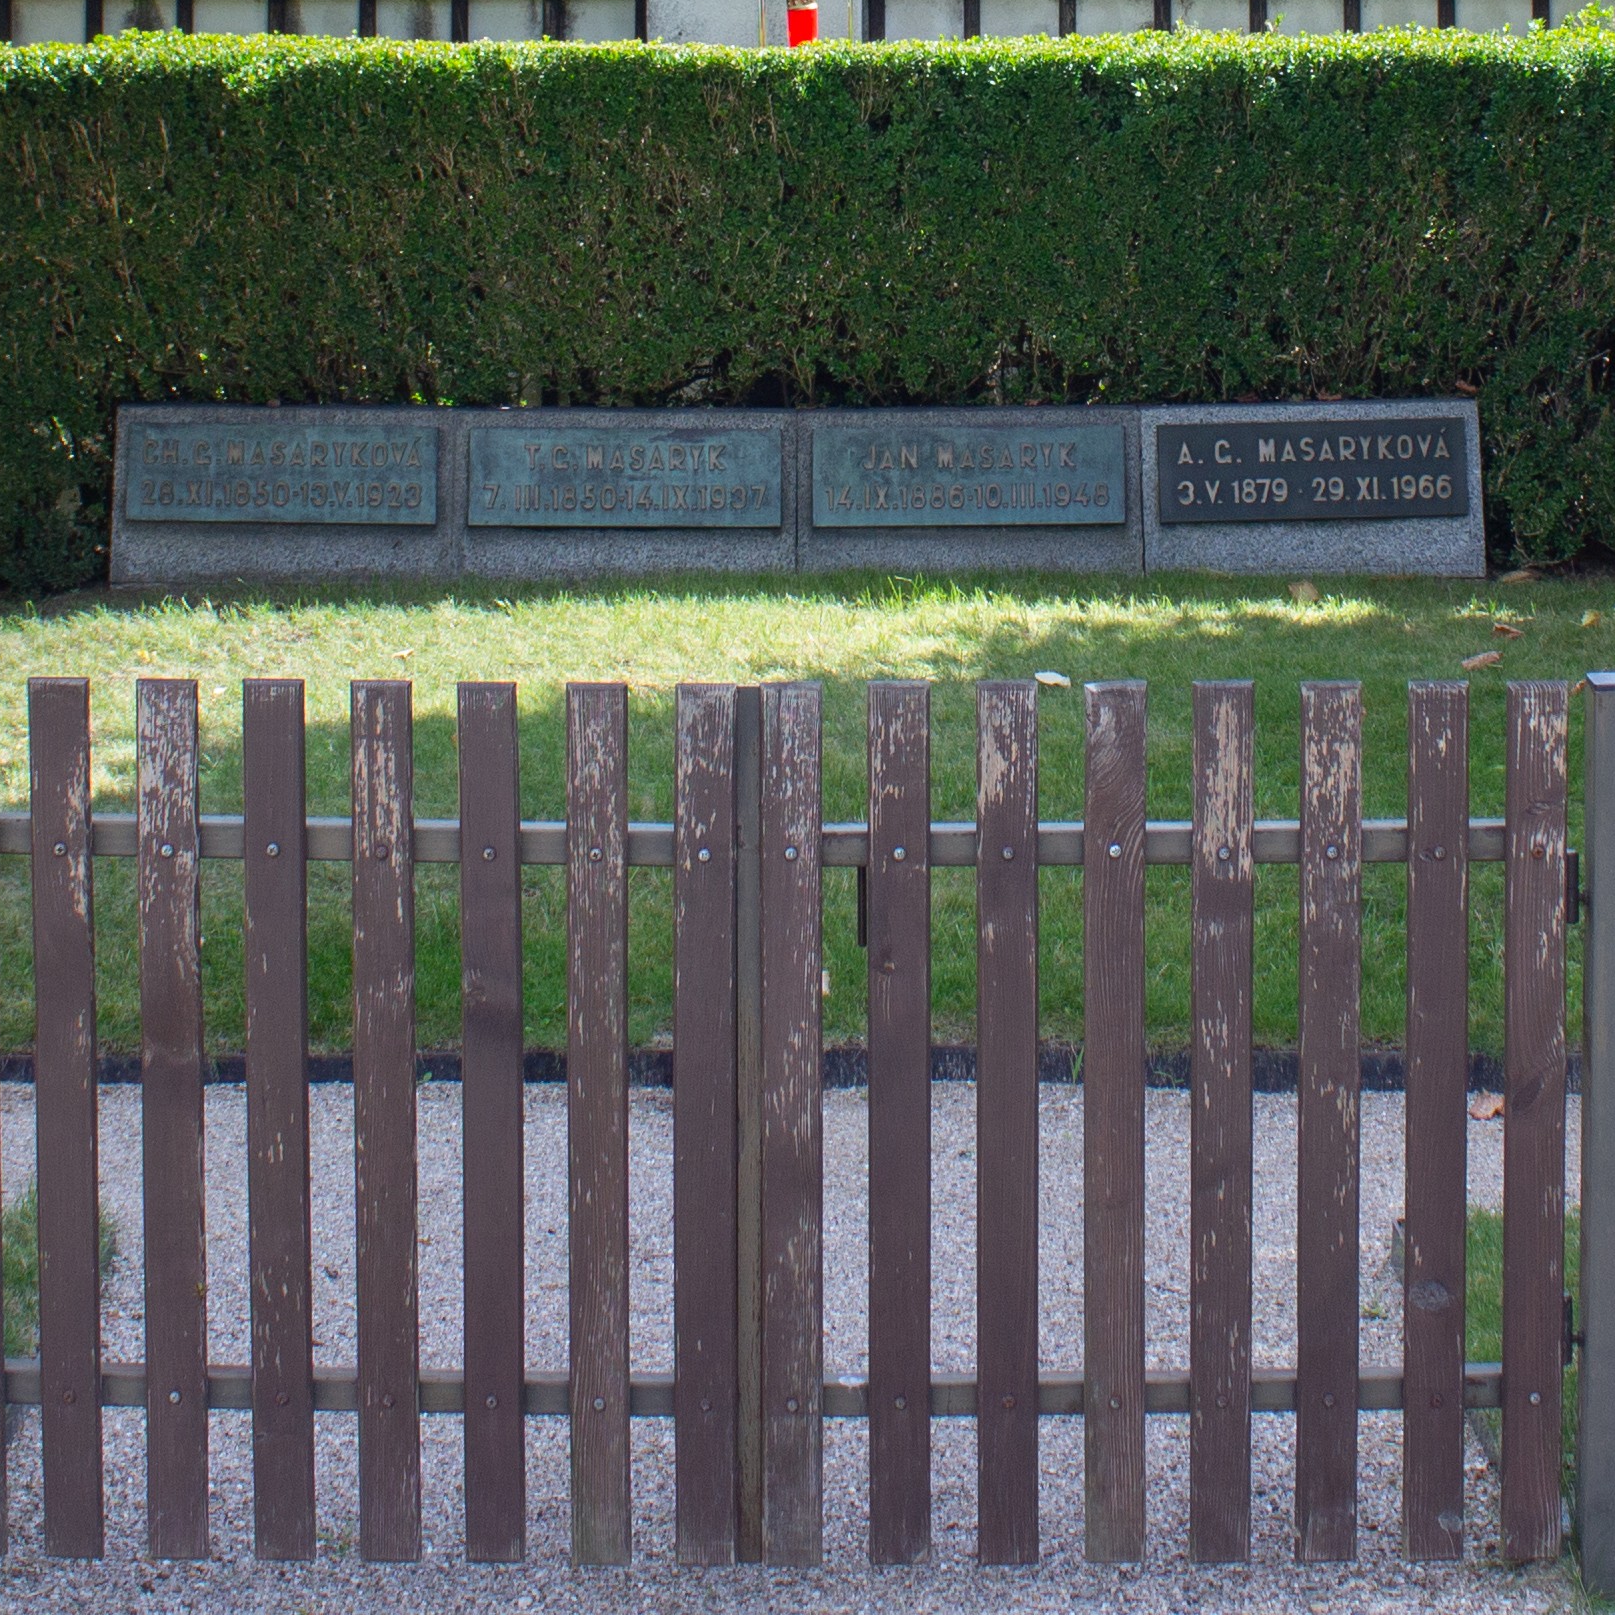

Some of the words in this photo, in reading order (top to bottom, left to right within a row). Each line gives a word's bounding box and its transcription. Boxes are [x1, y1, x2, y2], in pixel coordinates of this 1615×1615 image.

[586, 444, 727, 471] MASARYK
[862, 444, 919, 470] JAN
[937, 442, 1077, 470] MASARYK
[1177, 442, 1204, 465] A.
[1214, 439, 1242, 464] G.
[1258, 428, 1451, 463] MASARYKOVÁ
